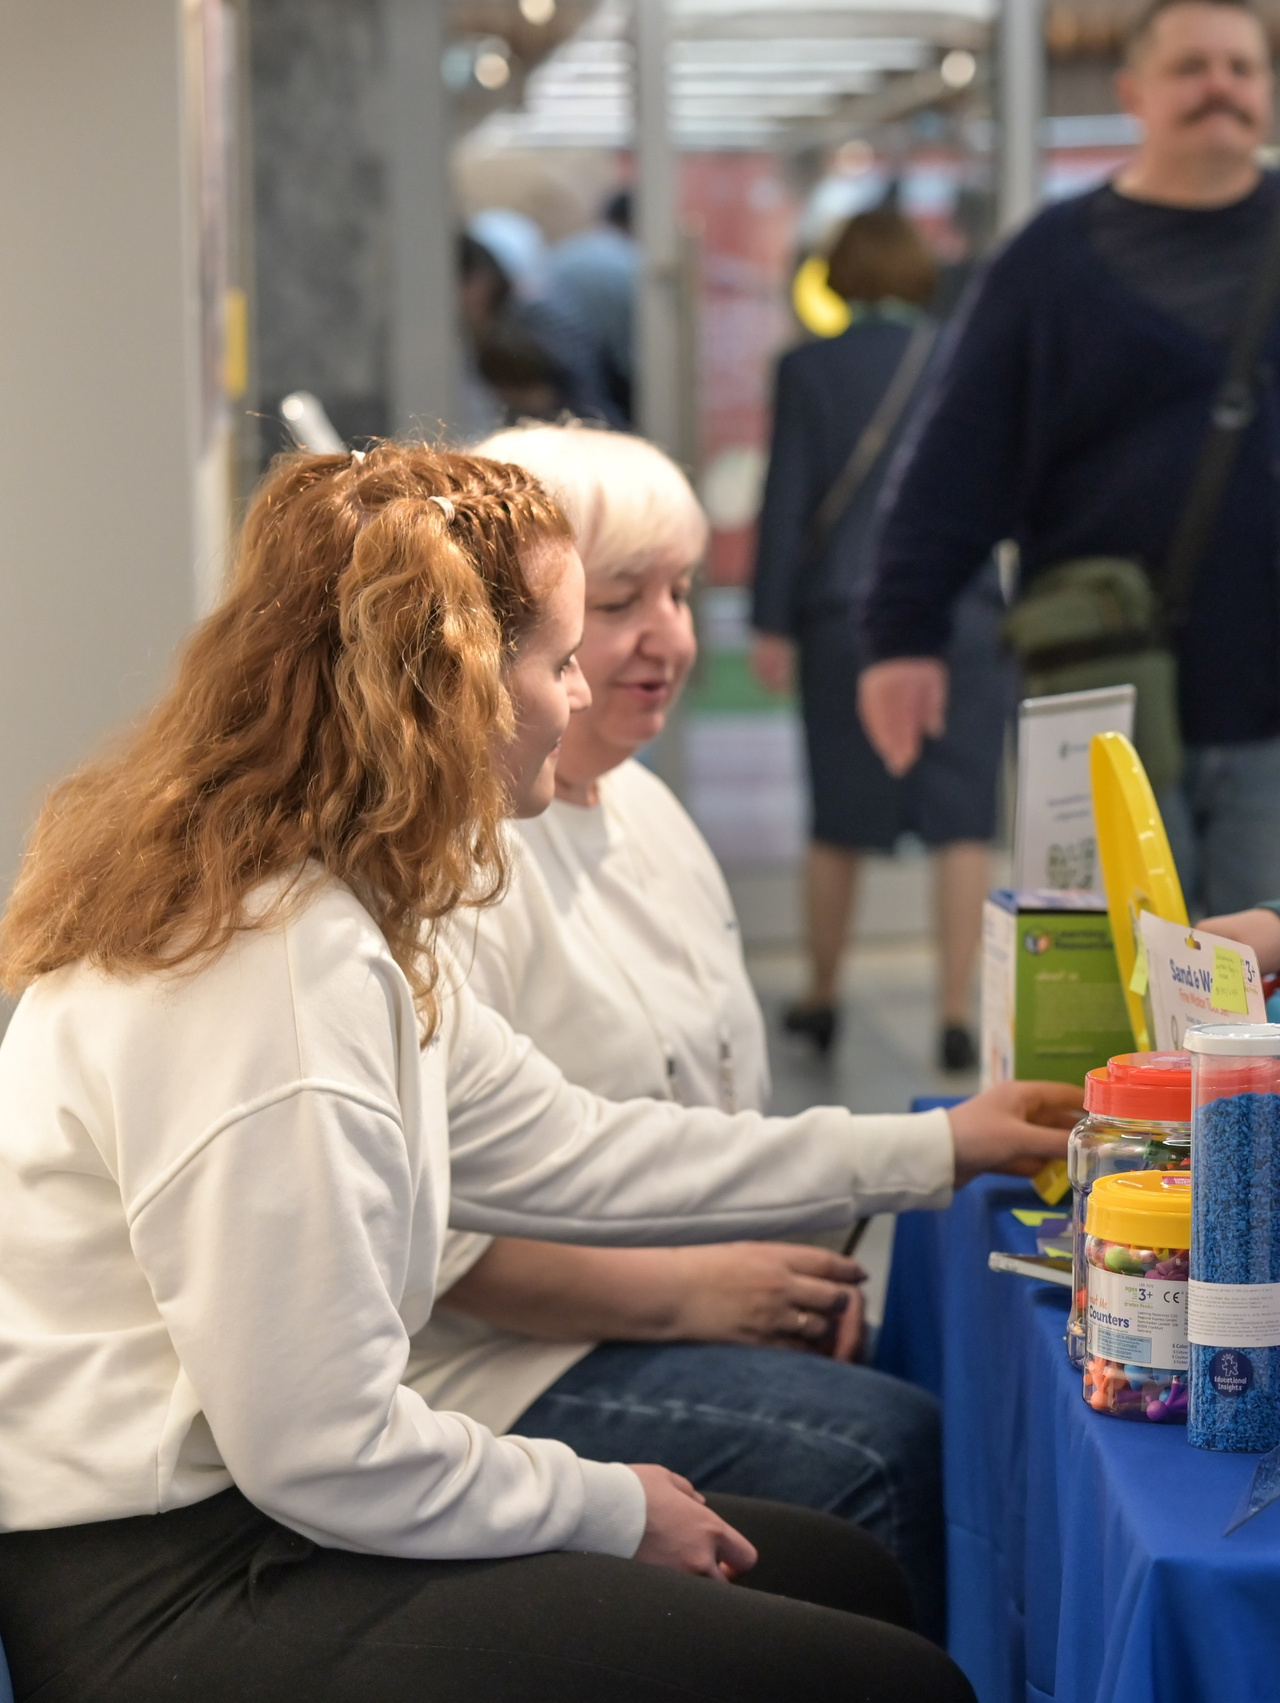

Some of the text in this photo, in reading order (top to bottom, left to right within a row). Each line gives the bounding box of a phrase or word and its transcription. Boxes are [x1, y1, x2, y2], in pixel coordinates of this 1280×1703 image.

[1170, 958, 1194, 988] Sand
[1194, 971, 1200, 989] &
[1138, 1289, 1153, 1301] 3+
[1089, 1305, 1130, 1328] Counters
[1214, 1376, 1247, 1384] Educational
[1218, 1384, 1242, 1392] Insights
